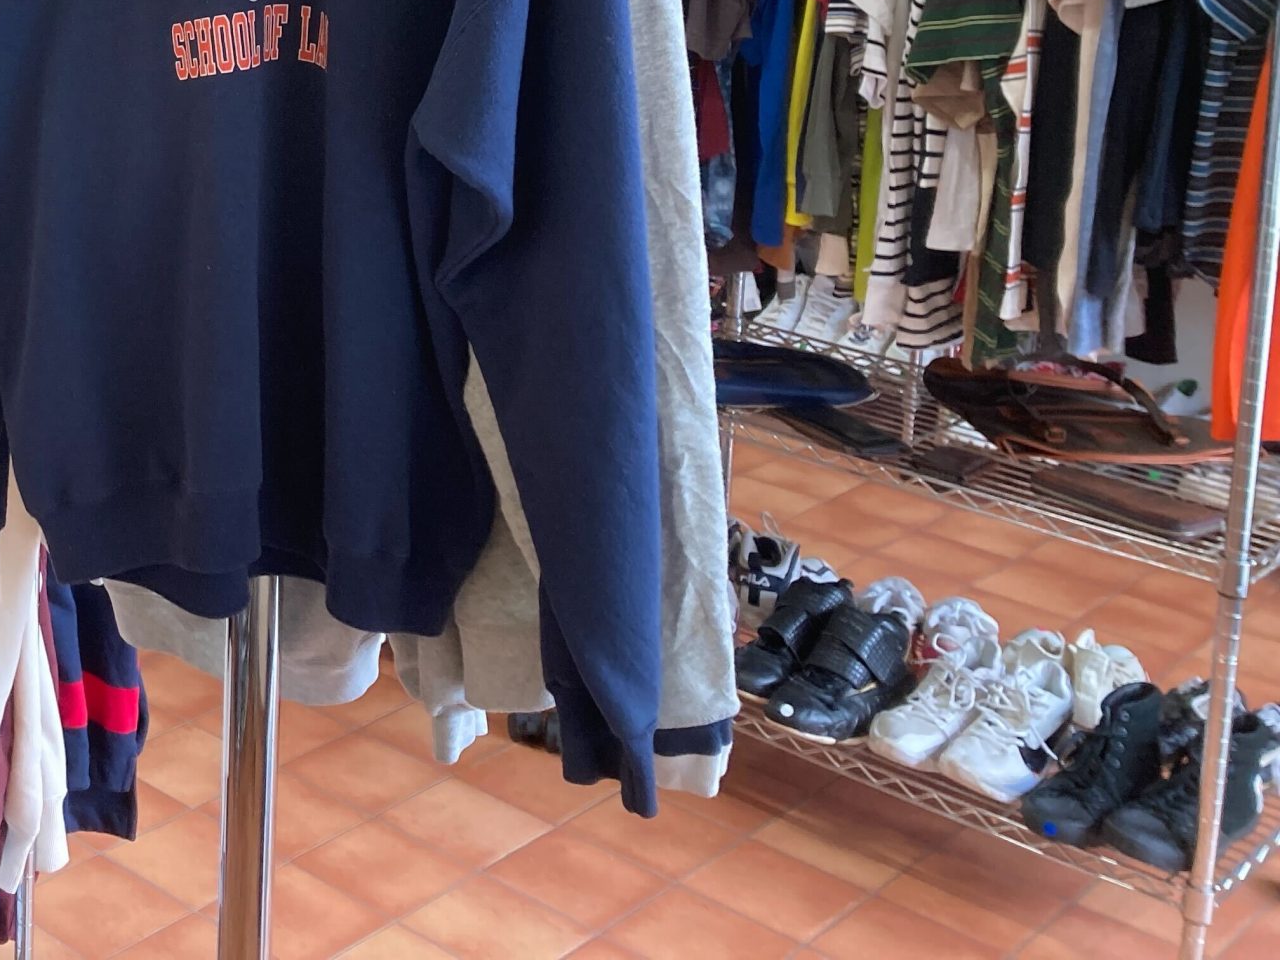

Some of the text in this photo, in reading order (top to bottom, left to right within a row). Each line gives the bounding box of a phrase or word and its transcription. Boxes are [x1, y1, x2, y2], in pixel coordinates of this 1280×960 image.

[172, 4, 329, 80] SCHOOL OF LA
